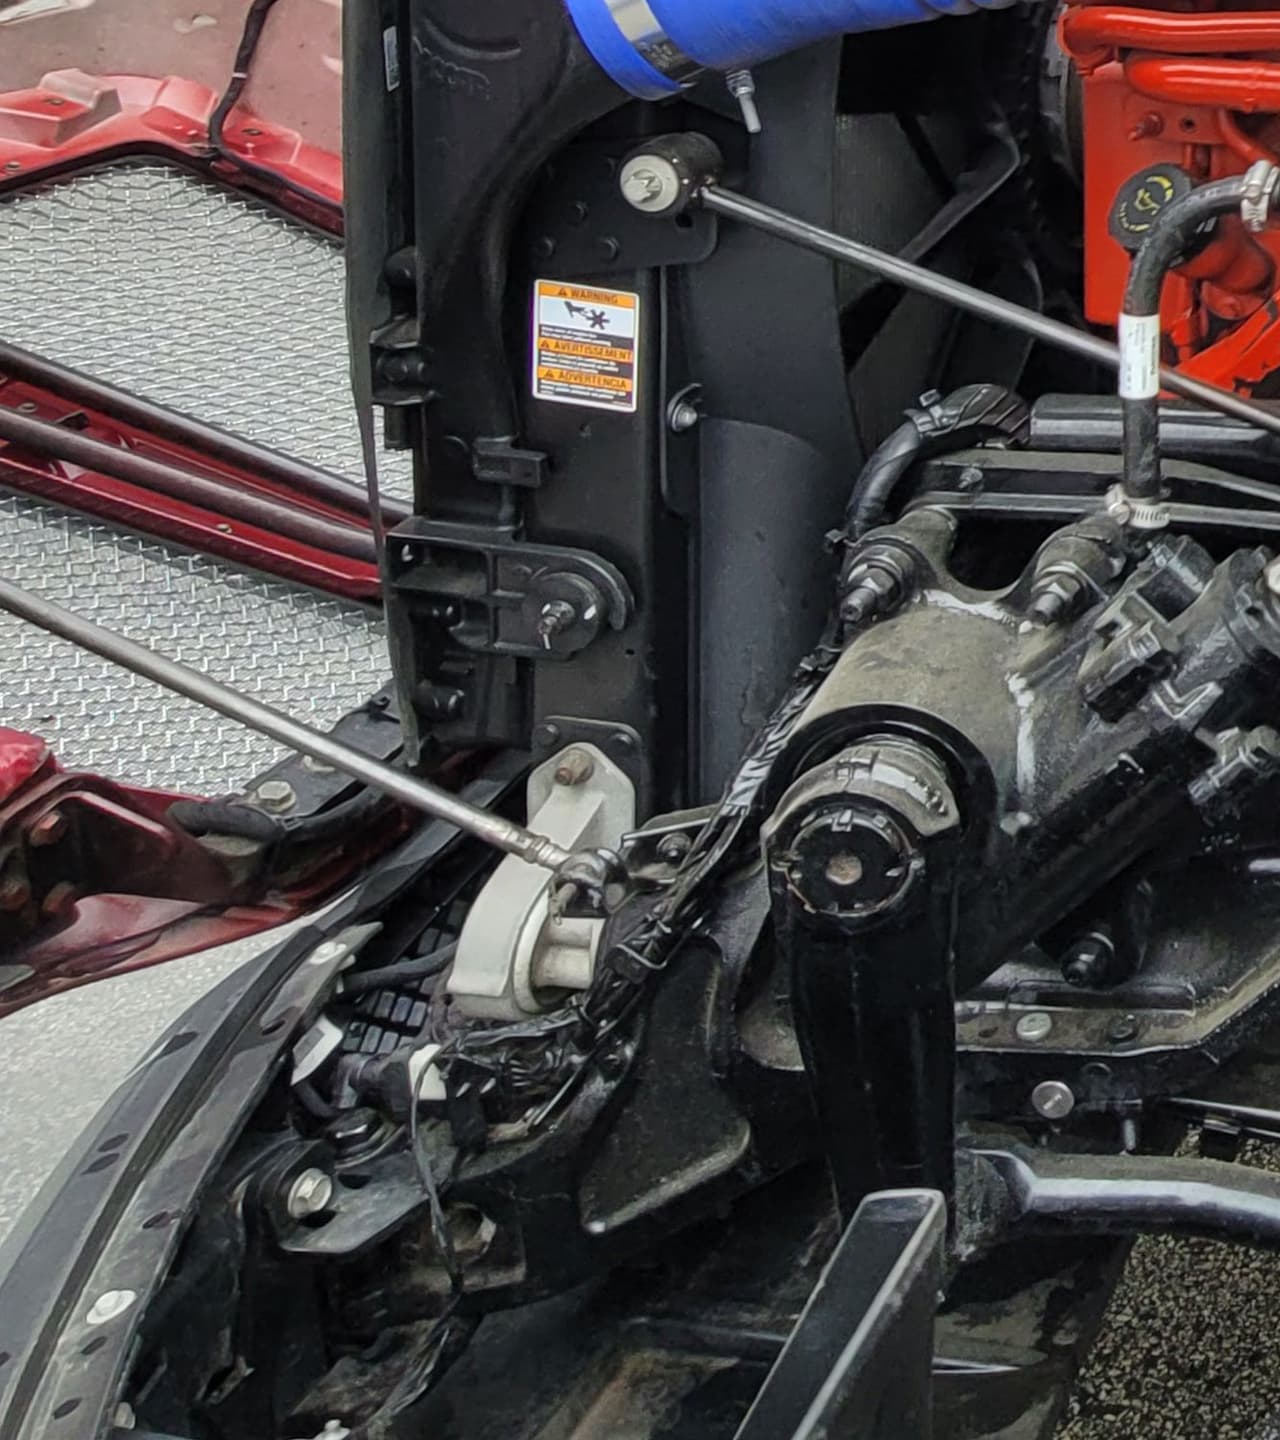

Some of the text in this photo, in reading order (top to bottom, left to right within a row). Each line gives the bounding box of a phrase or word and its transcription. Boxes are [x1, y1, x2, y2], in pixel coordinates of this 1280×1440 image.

[571, 289, 619, 304] WARNING
[554, 341, 631, 361] AVERTISSEMENT
[559, 371, 627, 389] ADVERTENCIA
